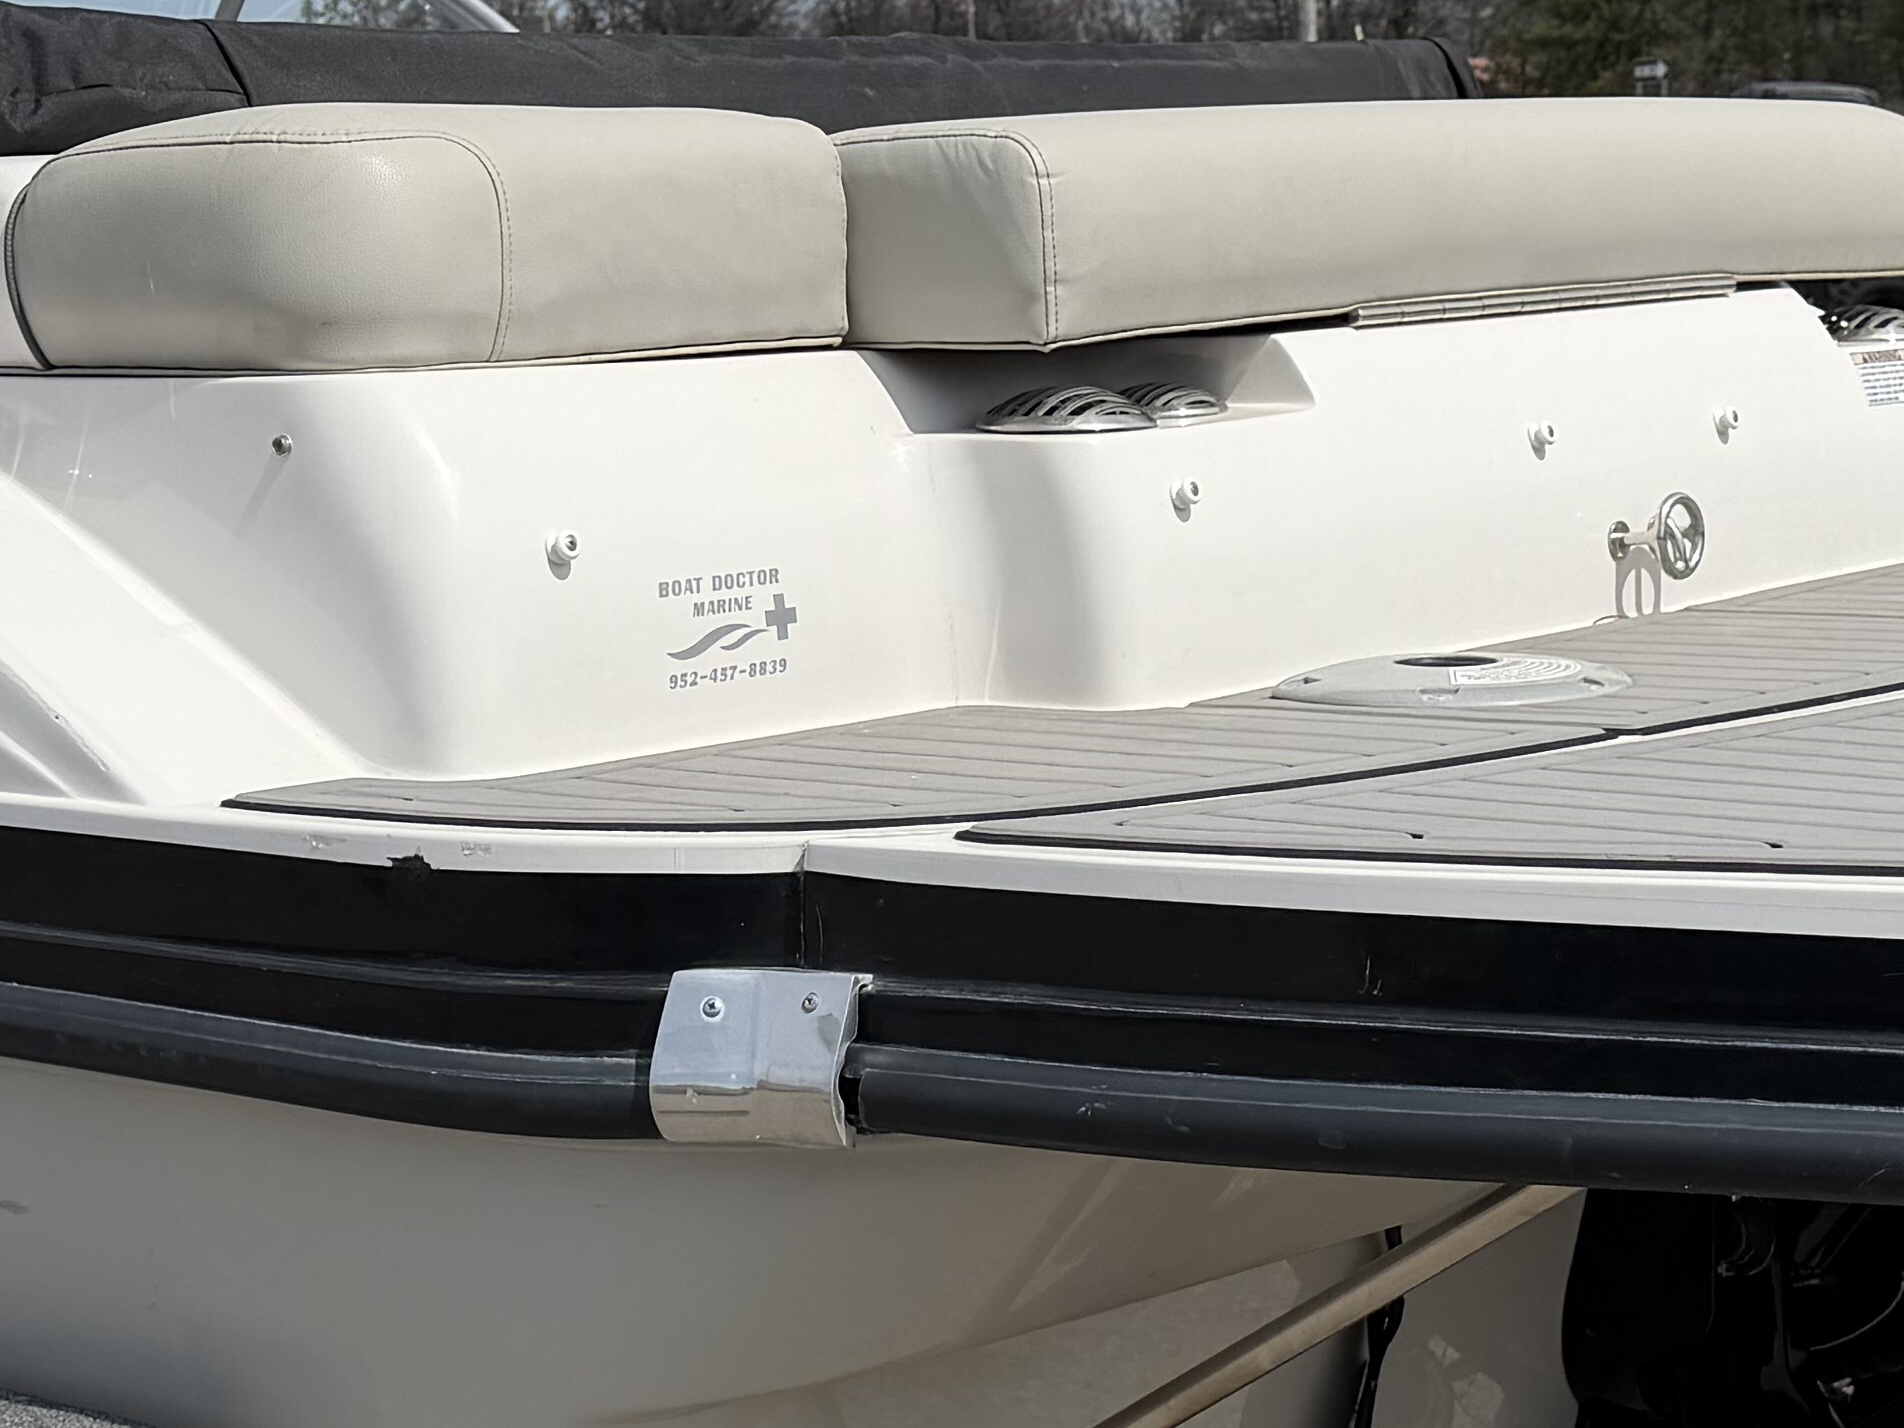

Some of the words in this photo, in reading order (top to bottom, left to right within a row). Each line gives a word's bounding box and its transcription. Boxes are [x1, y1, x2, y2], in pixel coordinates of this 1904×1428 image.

[658, 576, 702, 598] BOAT
[711, 568, 780, 592] DOCTOR
[692, 595, 753, 618] MARINE
[669, 658, 788, 690] 952-457-8839
